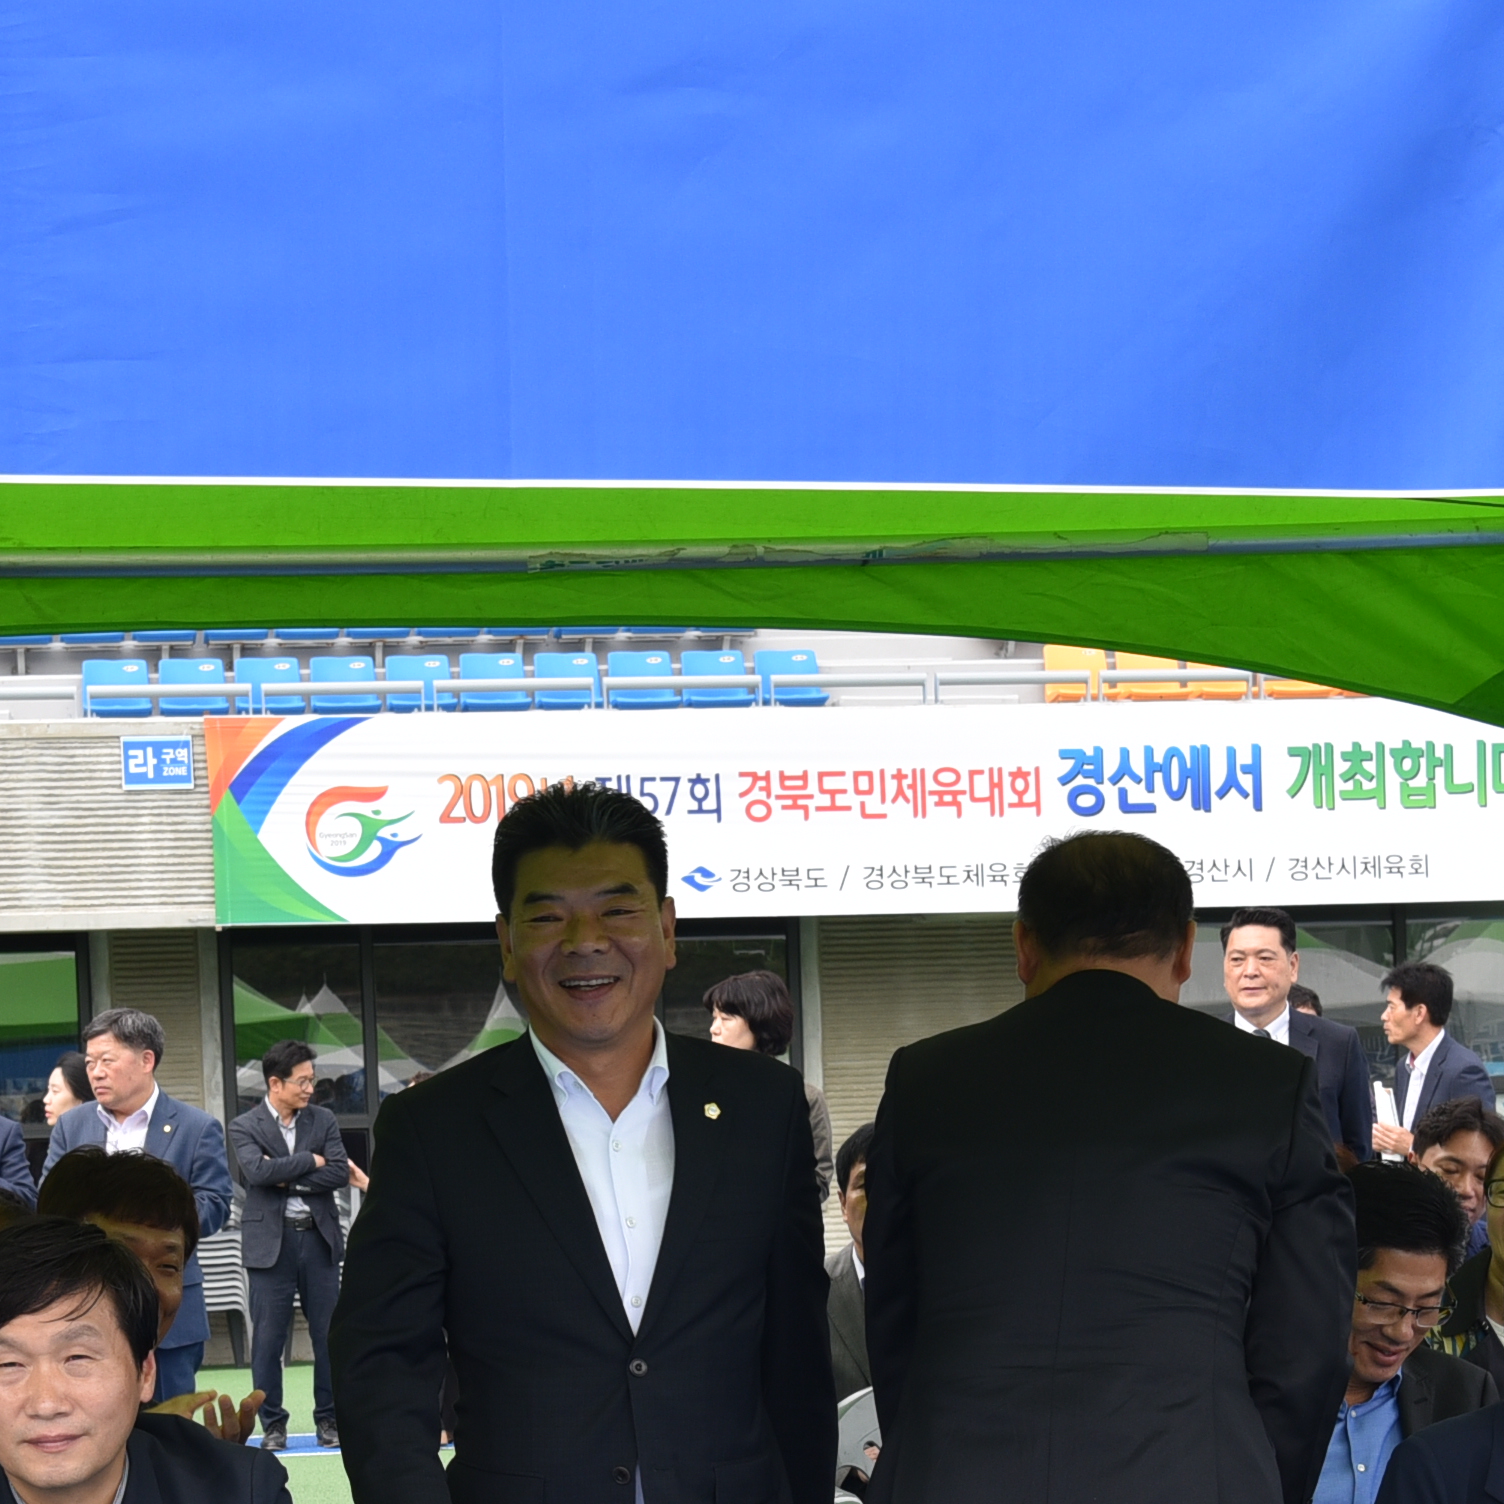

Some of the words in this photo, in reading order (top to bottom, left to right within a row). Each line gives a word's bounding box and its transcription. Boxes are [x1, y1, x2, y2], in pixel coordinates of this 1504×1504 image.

[128, 747, 158, 779] 라
[161, 748, 189, 765] 구역
[162, 766, 188, 776] ZONE
[437, 773, 574, 824] 2019
[738, 766, 1042, 823] 경북도민체육대회
[1057, 744, 1263, 818] 경산에서
[729, 866, 829, 893] 경상북도
[1184, 858, 1253, 884] 경산시
[1288, 854, 1430, 881] 경산시체육회
